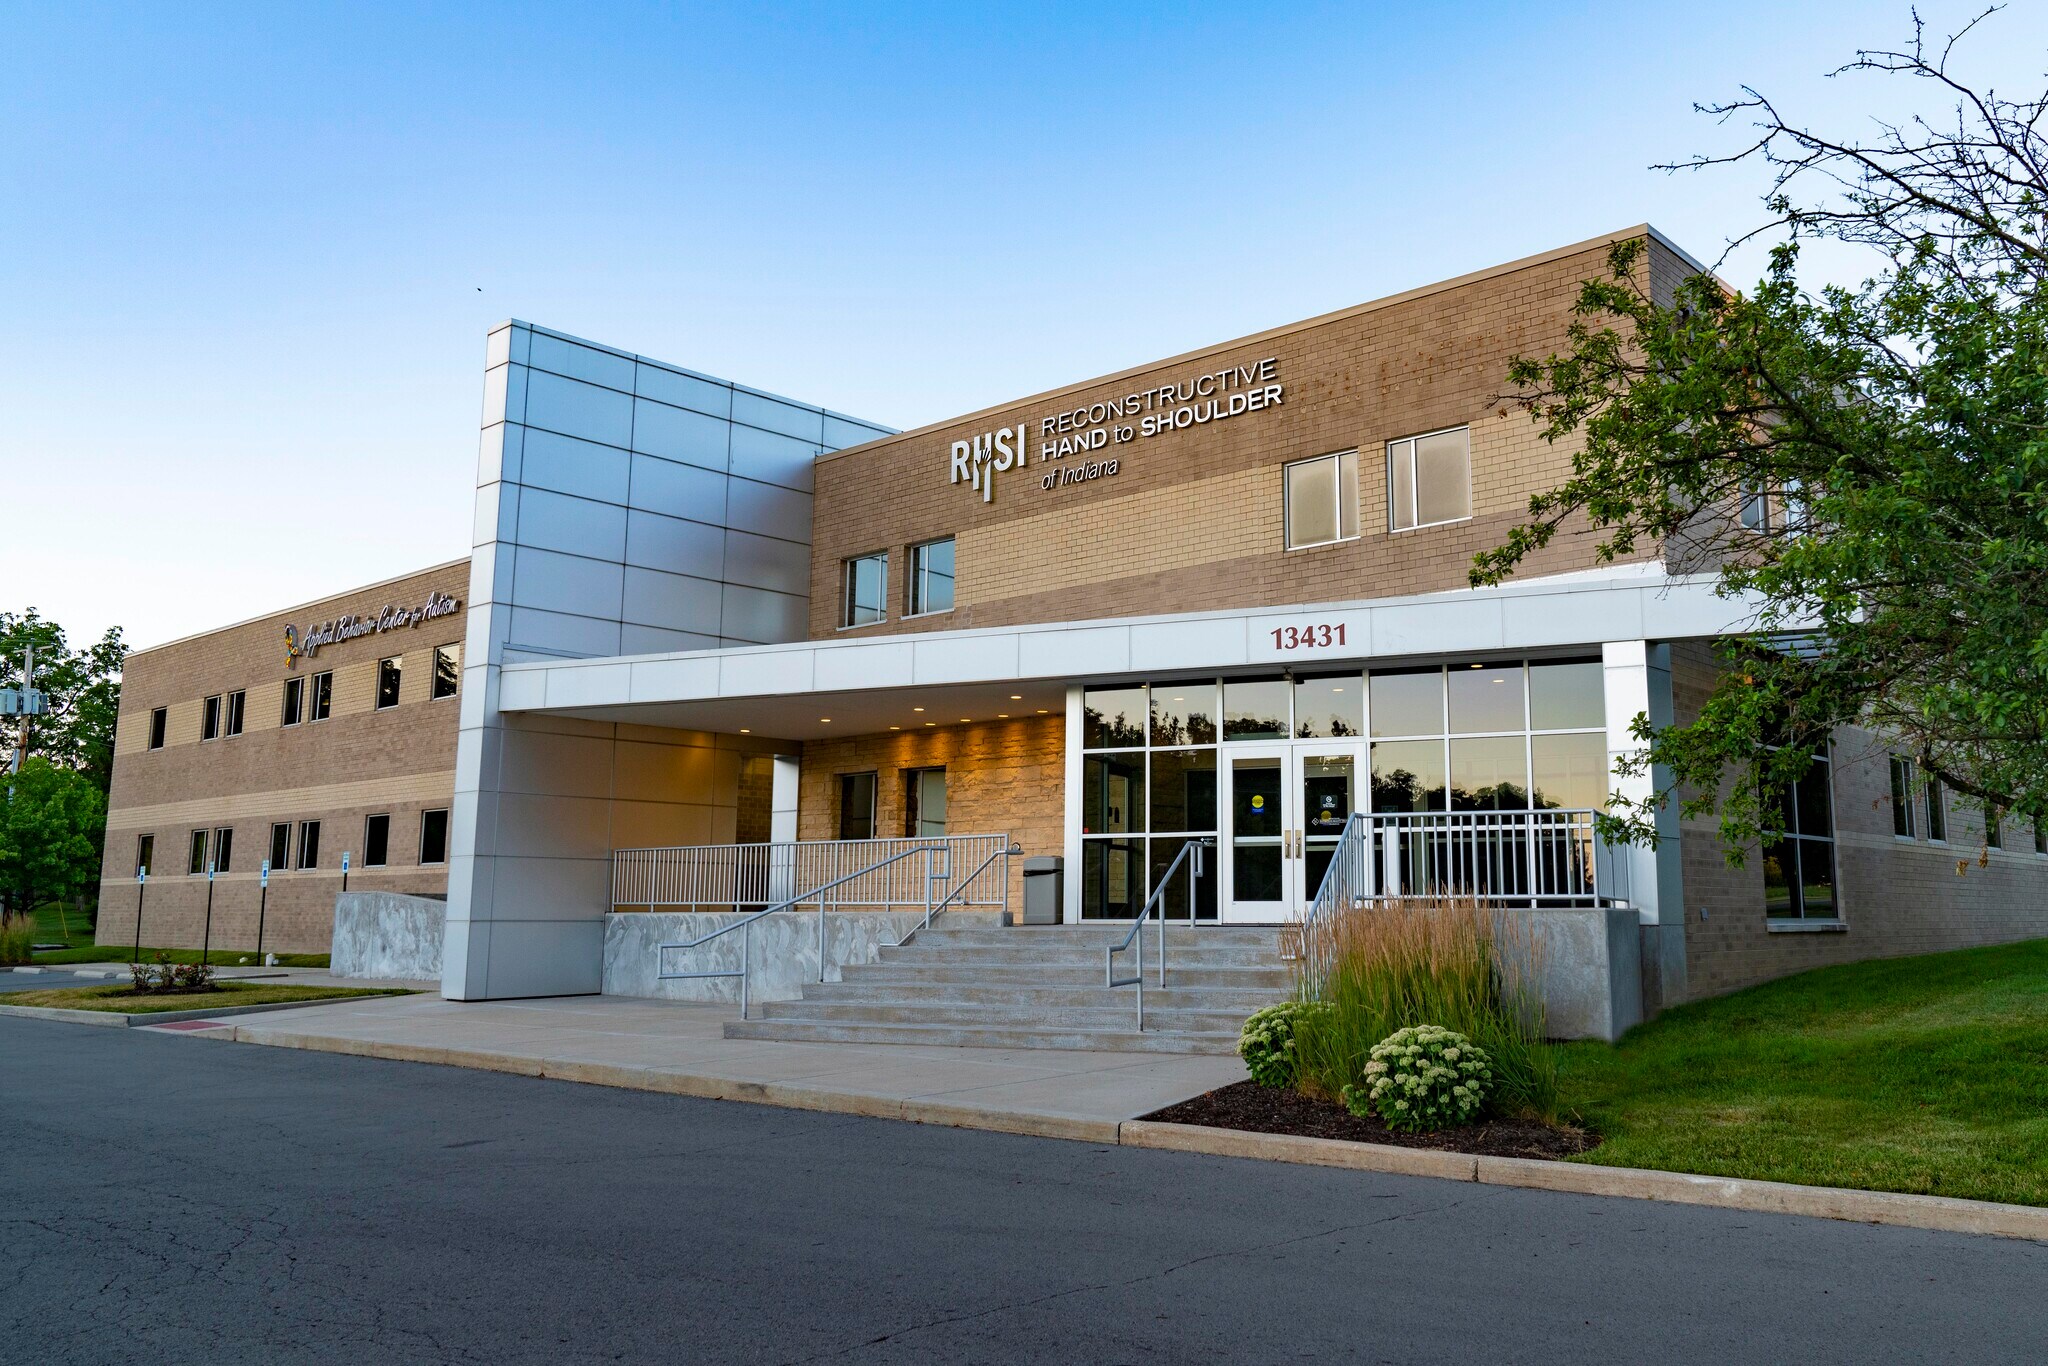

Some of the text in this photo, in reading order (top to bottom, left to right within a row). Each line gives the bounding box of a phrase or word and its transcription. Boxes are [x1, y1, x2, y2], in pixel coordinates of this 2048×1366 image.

[1042, 357, 1278, 437] RECONSTRUCTIVE
[1042, 384, 1284, 461] HAND to SHOULDER
[1041, 459, 1119, 490] of Indiana
[302, 591, 458, 658] Applied Behavior Center for Autism
[1270, 622, 1346, 650] 13431
